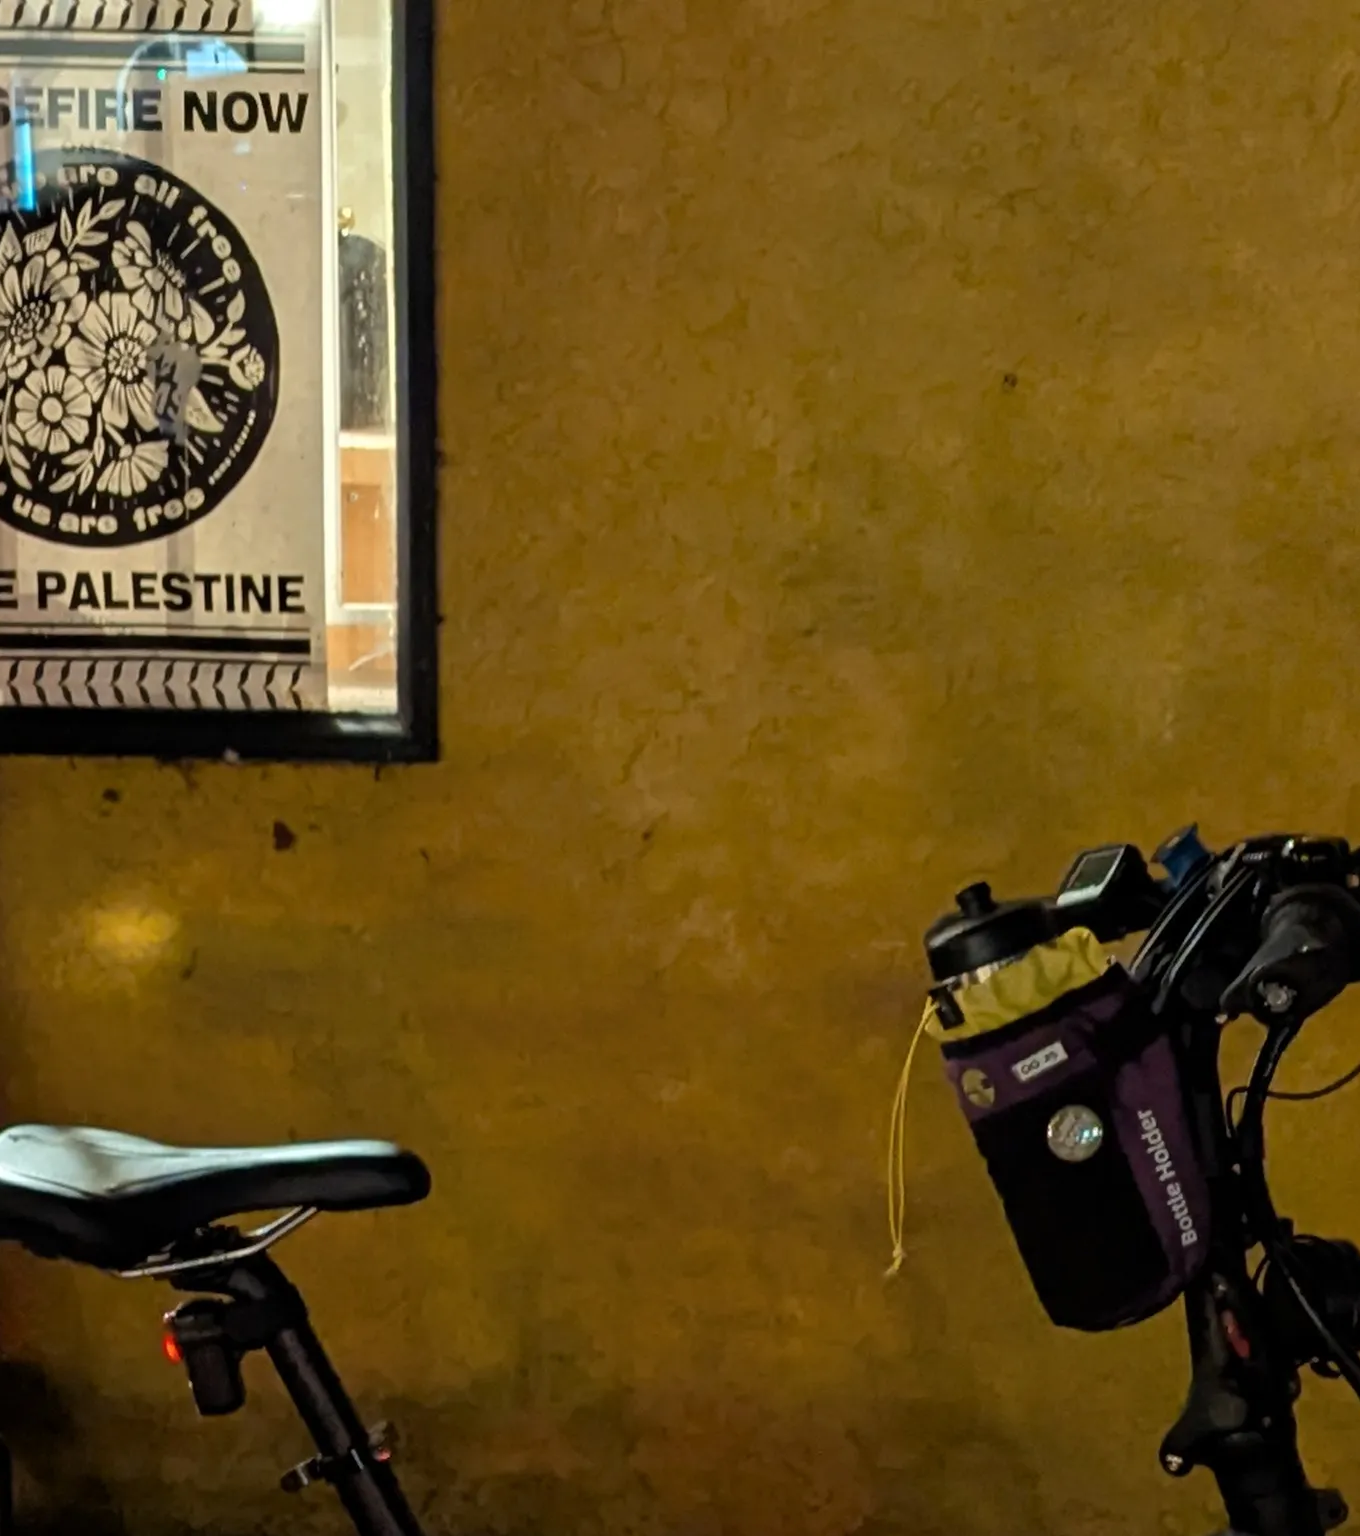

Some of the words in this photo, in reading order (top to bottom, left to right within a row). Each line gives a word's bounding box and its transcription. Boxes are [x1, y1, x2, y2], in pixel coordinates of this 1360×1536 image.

[183, 90, 310, 133] NOW
[134, 173, 180, 209] all
[188, 205, 241, 283] free
[58, 511, 119, 535] are
[132, 487, 205, 532] free
[37, 569, 306, 614] PALESTINE
[1137, 1109, 1177, 1183] Holder
[1166, 1181, 1198, 1247] Bottle
